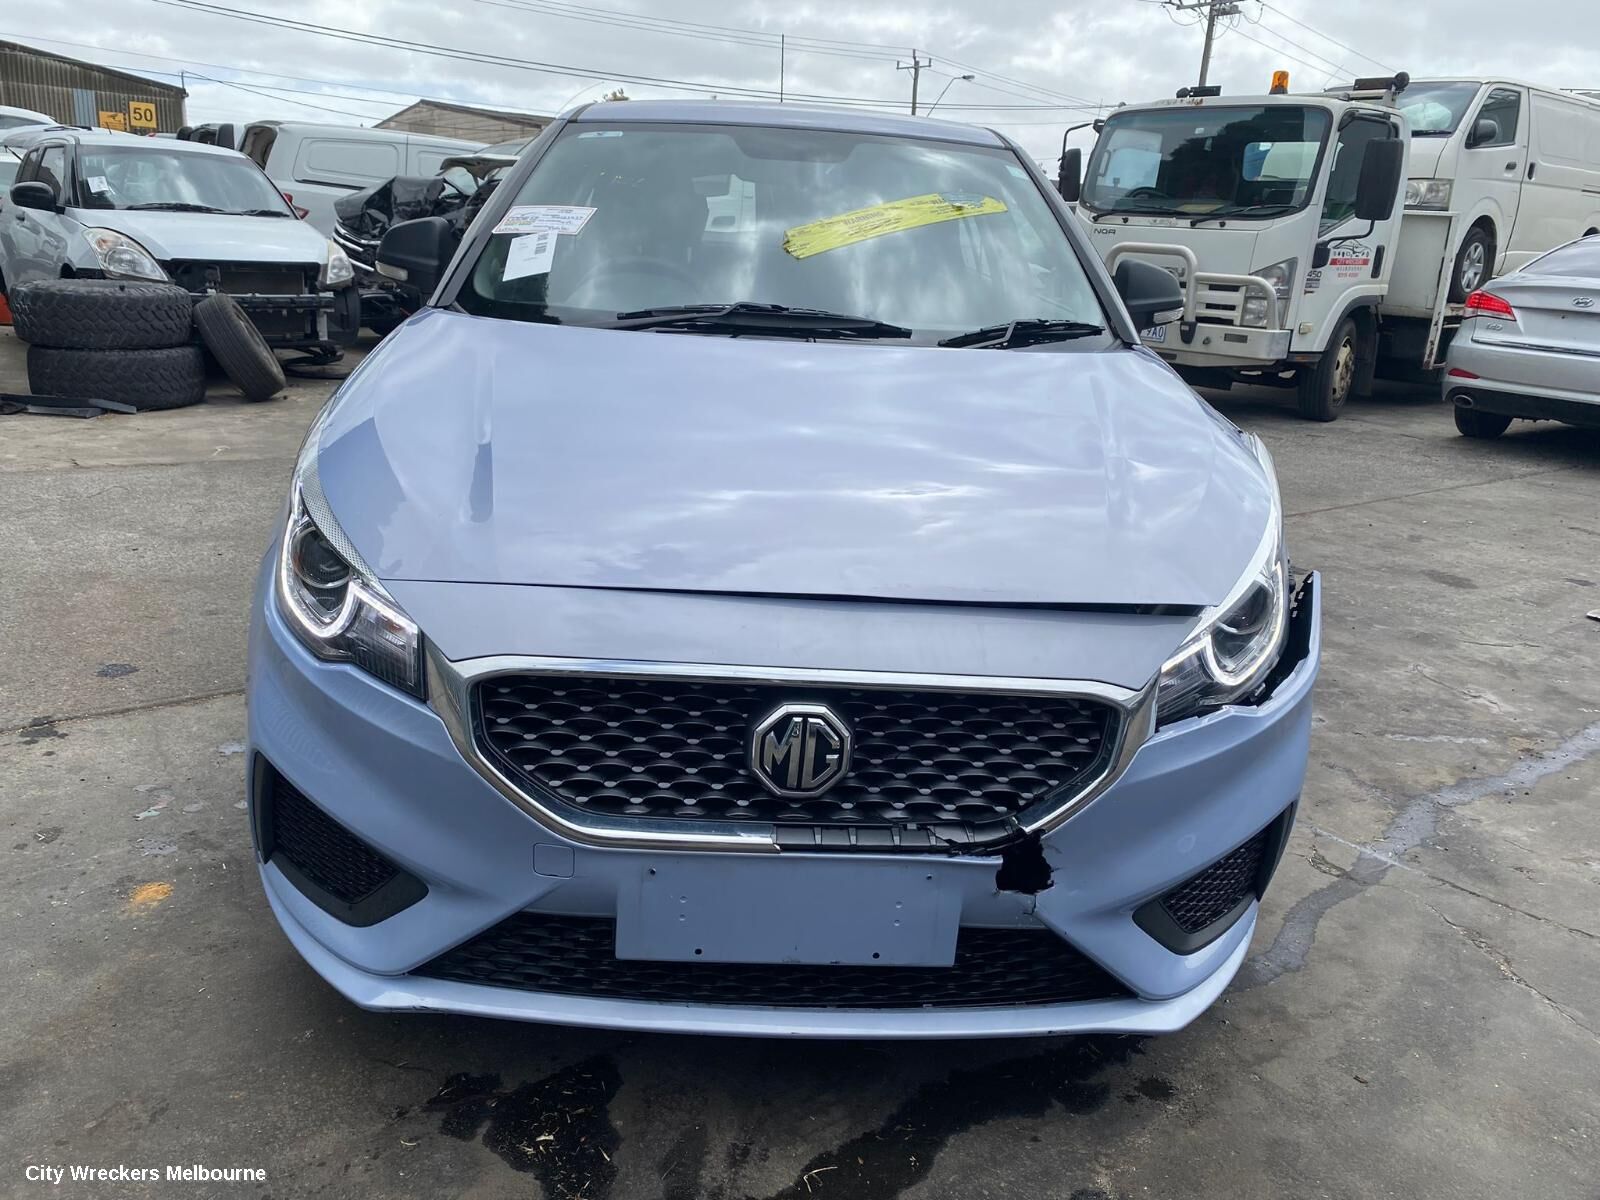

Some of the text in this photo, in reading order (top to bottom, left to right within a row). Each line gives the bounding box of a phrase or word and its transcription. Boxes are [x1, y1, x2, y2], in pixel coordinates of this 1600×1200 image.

[133, 107, 153, 122] 50
[1307, 270, 1322, 278] 450
[763, 717, 840, 789] MG
